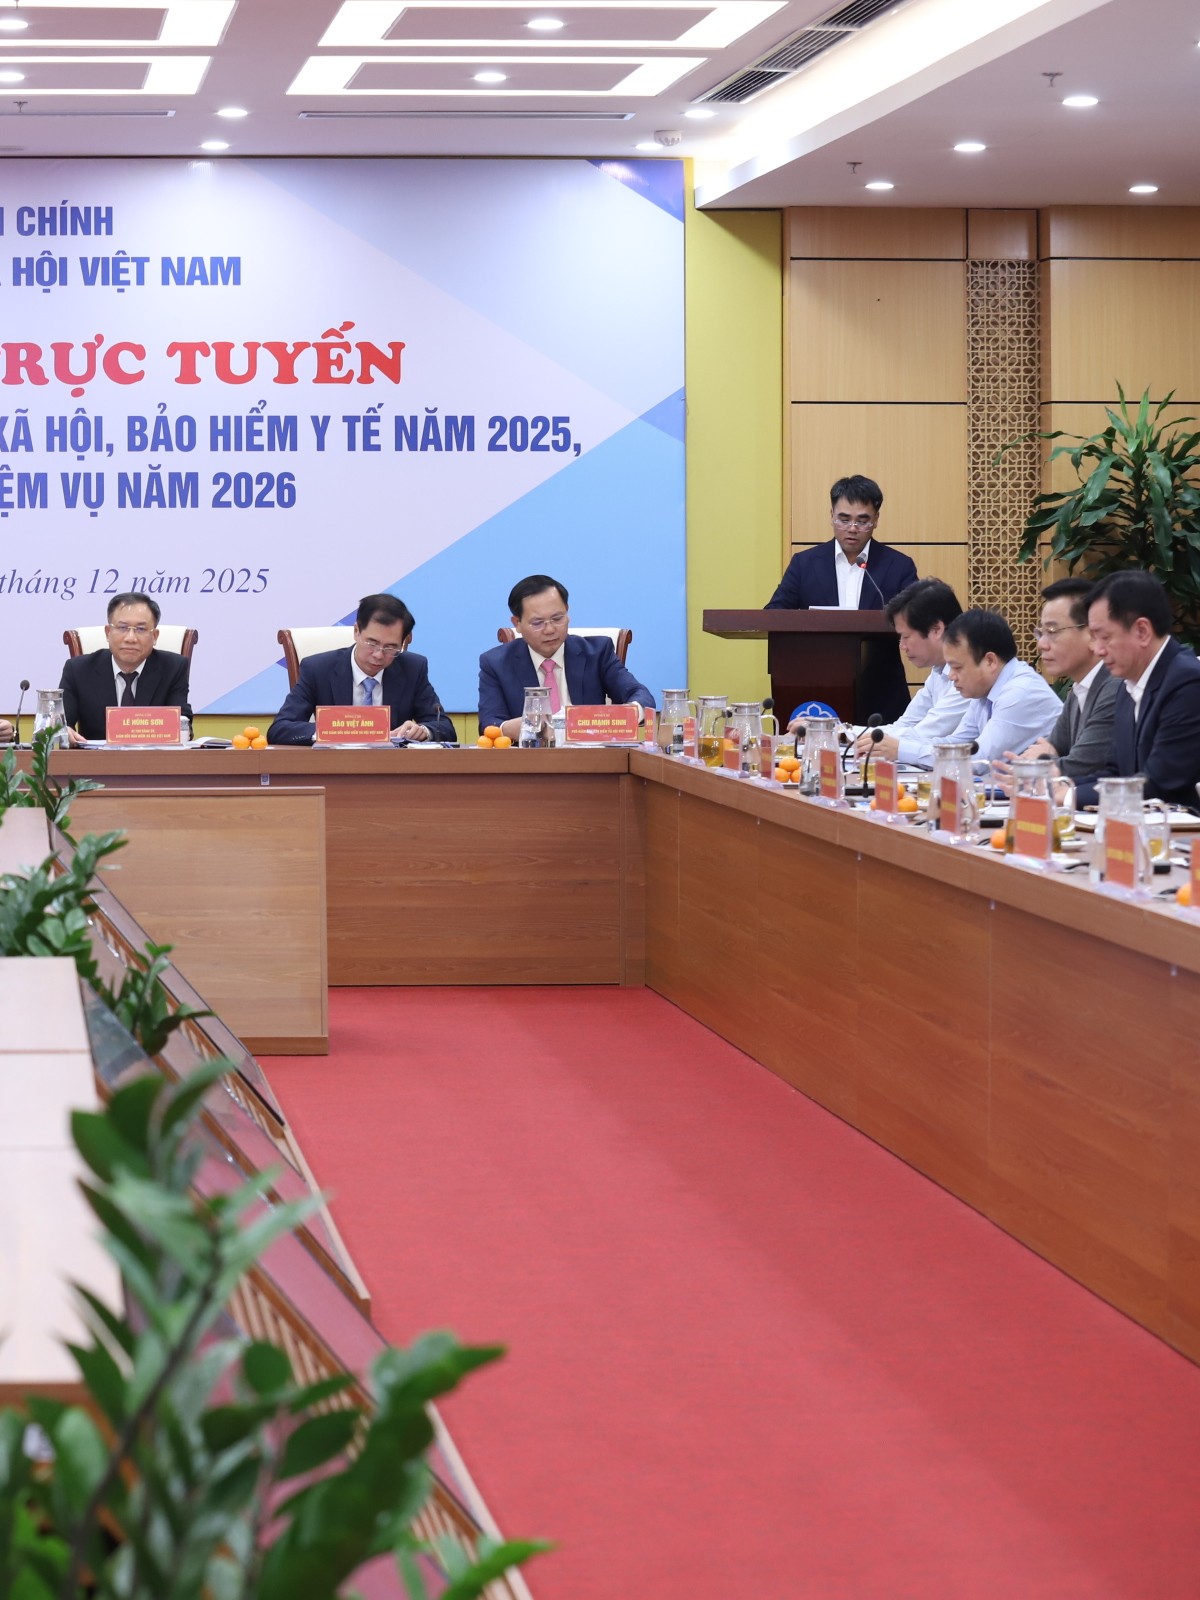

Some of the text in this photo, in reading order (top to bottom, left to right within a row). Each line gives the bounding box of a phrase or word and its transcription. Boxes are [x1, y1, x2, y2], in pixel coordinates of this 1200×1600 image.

[16, 200, 113, 236] CHÍNH
[12, 250, 68, 293] HỘI
[79, 250, 150, 293] VIỆT
[161, 256, 241, 286] NAM
[166, 321, 406, 385] TUYẾN
[45, 408, 114, 461] HỘI,
[127, 402, 197, 452] BẢO
[209, 400, 298, 452] HIỂM
[310, 415, 332, 452] Y
[341, 402, 385, 452] TẾ
[394, 406, 475, 452] NĂM
[487, 415, 582, 458] 2025,
[60, 472, 104, 517] VỤ
[117, 463, 199, 509] NĂM
[211, 471, 297, 509] 2026
[87, 568, 120, 594] 12
[130, 569, 191, 594] năm
[200, 567, 270, 594] 2025
